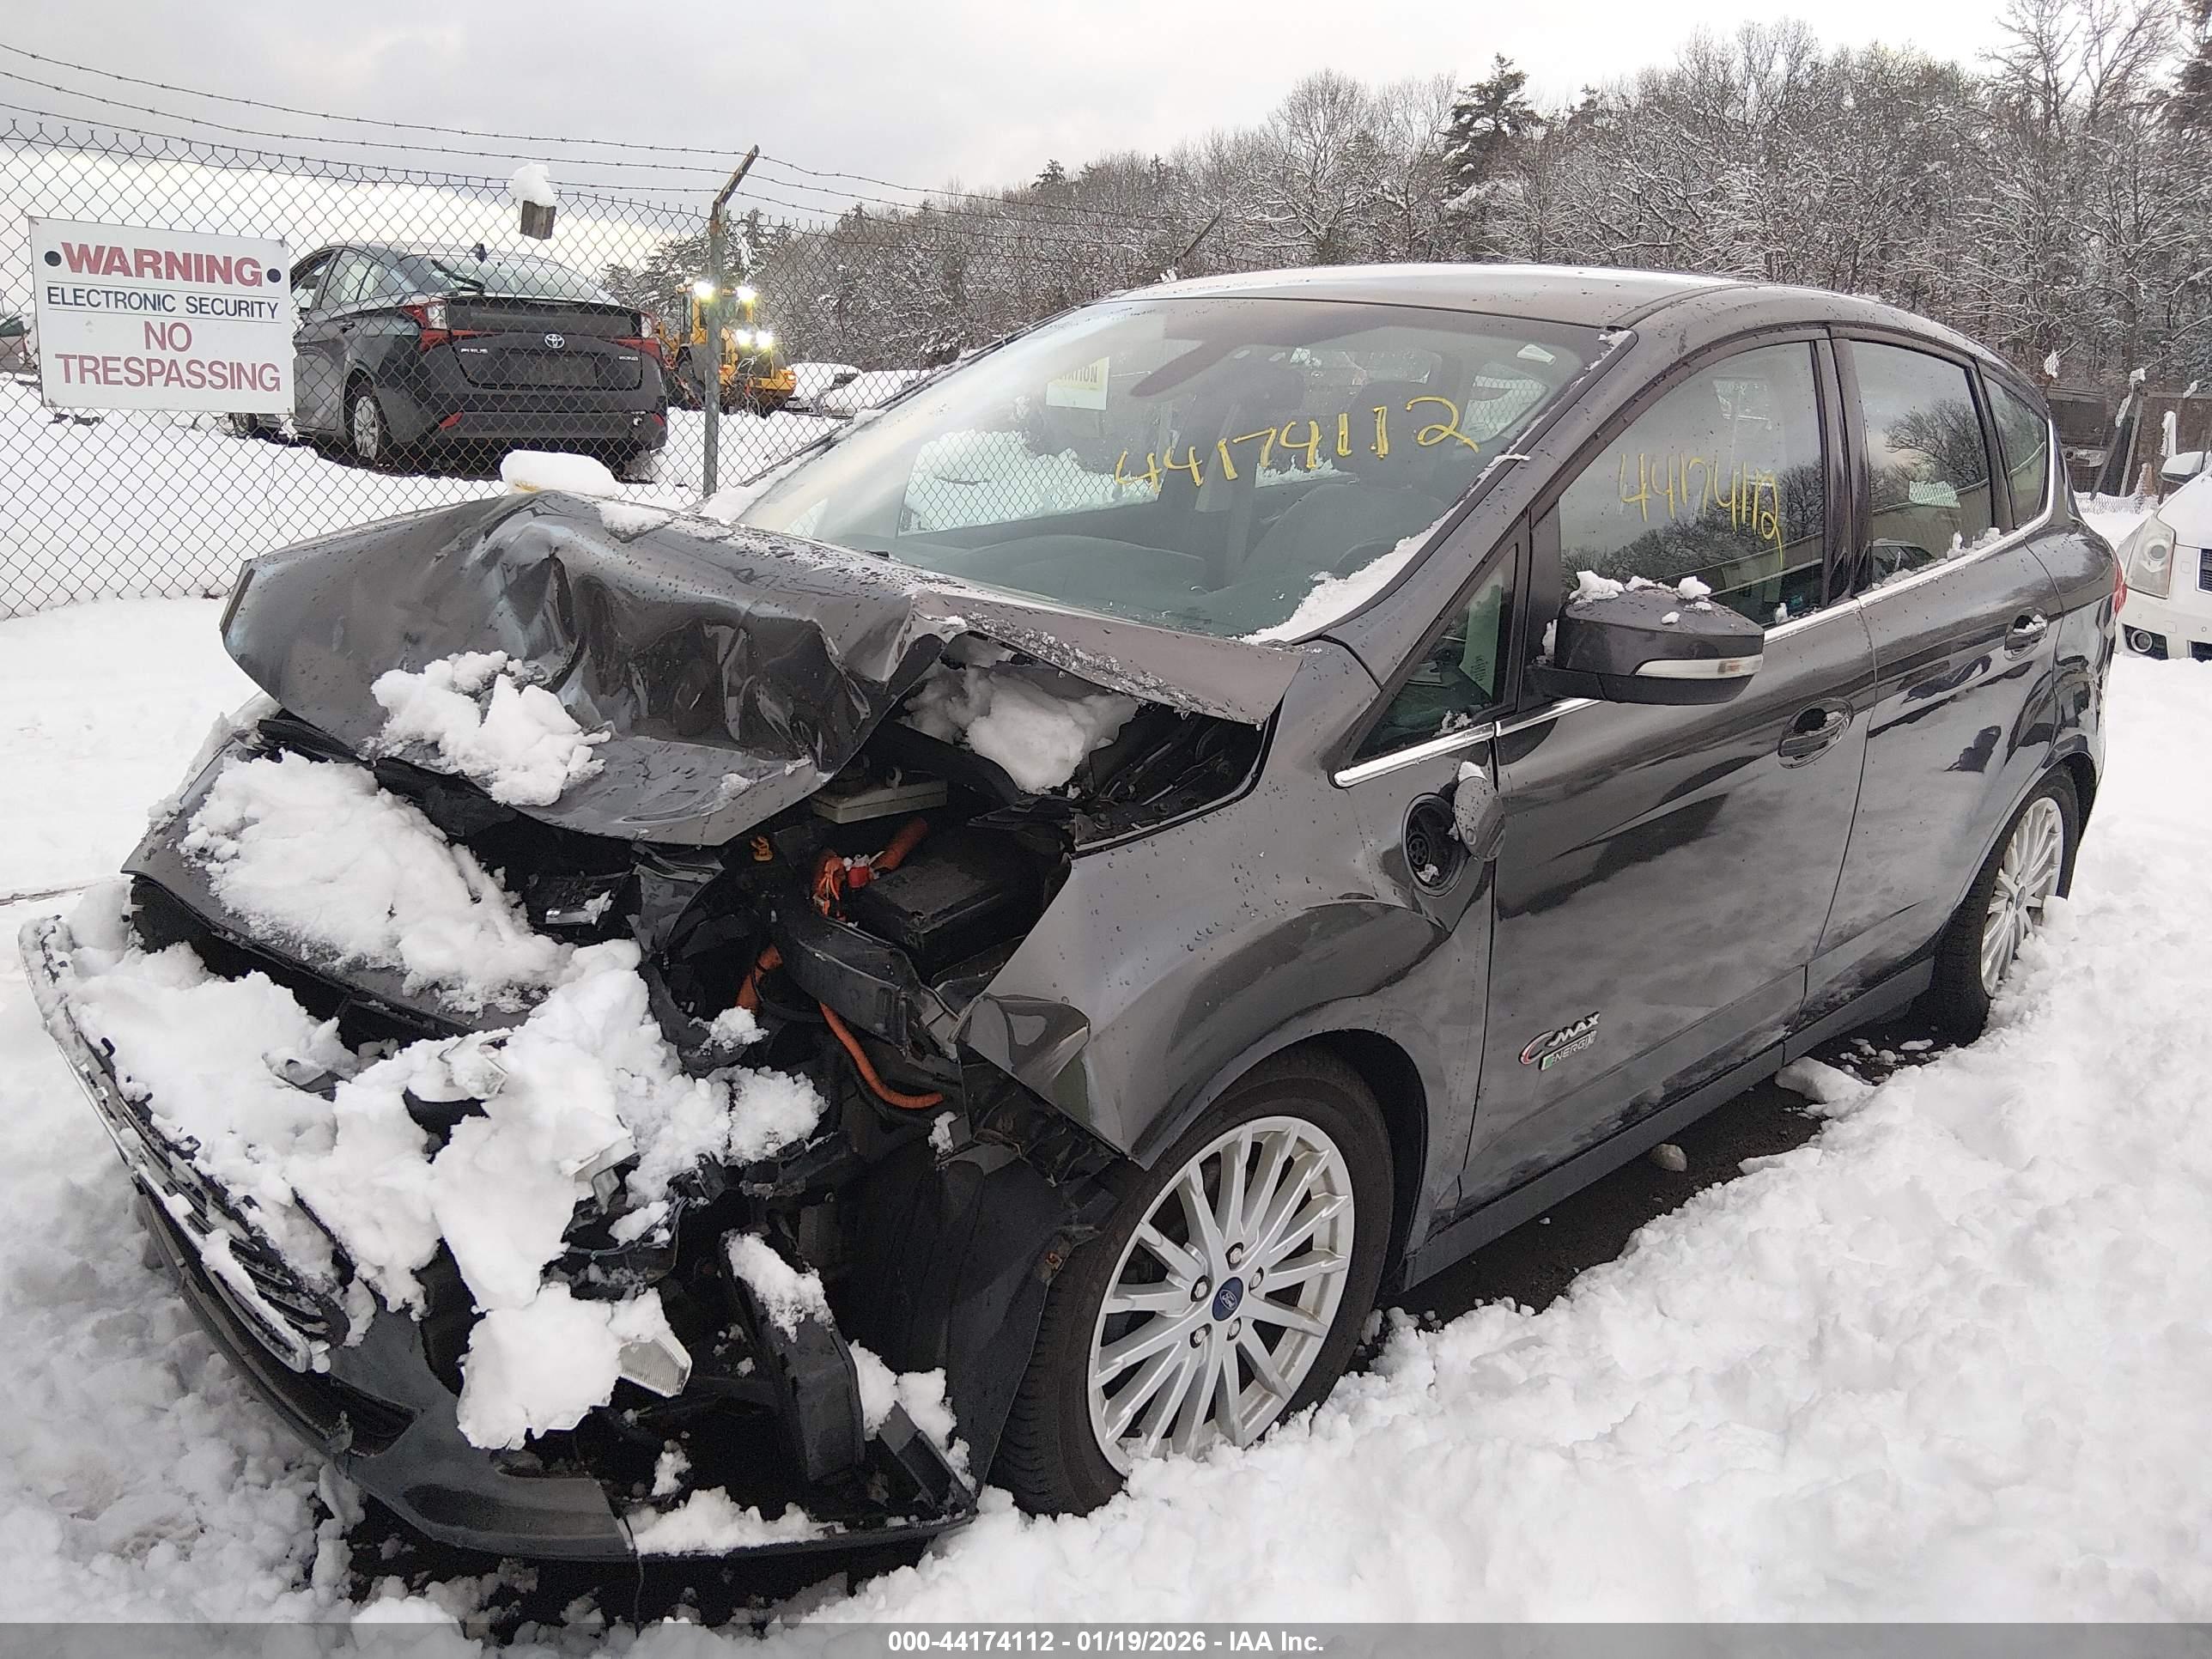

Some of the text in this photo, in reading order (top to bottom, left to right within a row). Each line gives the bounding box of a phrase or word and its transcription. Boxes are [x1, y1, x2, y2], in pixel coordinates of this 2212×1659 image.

[61, 241, 263, 287] WARNING
[47, 286, 279, 319] ELECTRONIC SECURITY
[143, 320, 192, 352] NO
[54, 353, 281, 392] TRESPASSING
[1115, 396, 1479, 495] 44174112
